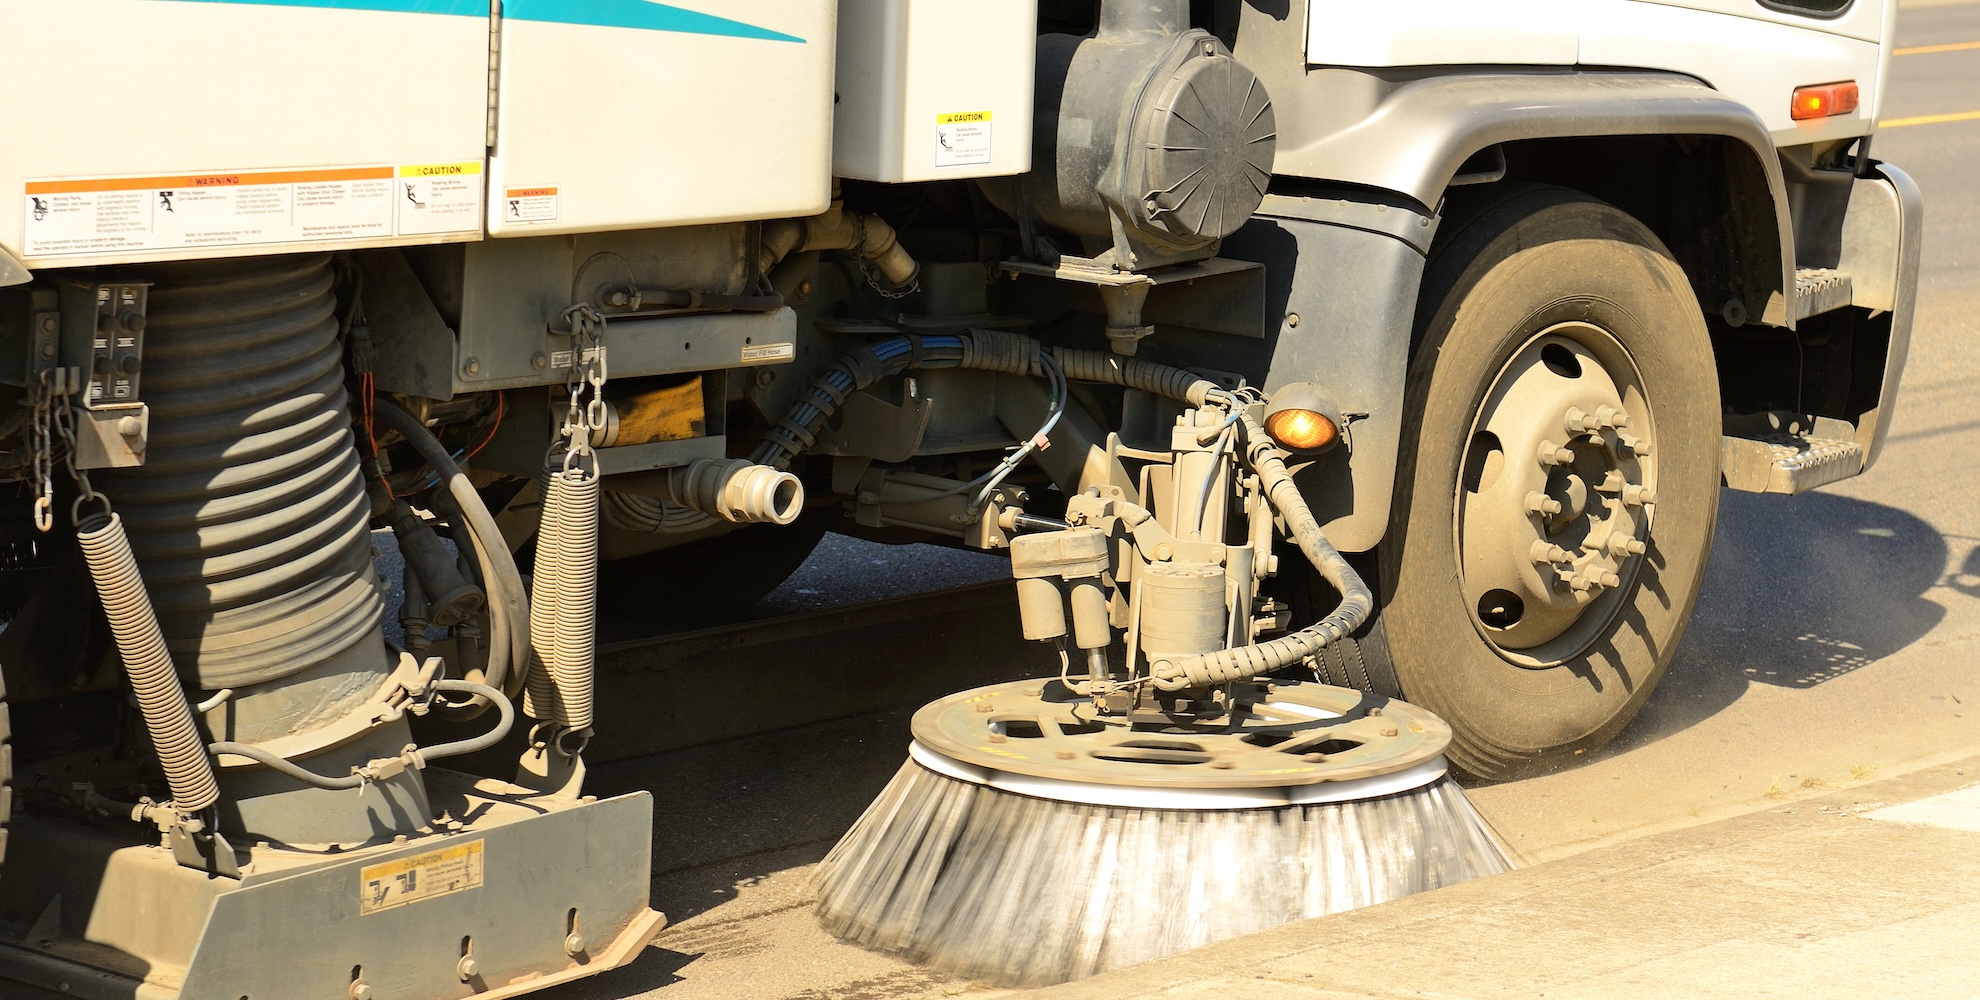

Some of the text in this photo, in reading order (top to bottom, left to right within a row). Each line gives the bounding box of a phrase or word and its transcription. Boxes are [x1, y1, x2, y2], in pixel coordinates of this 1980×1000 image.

[954, 113, 983, 122] CAUTION
[422, 166, 462, 175] CAUTION
[195, 176, 239, 186] WARNING
[411, 854, 442, 868] CAUTION
